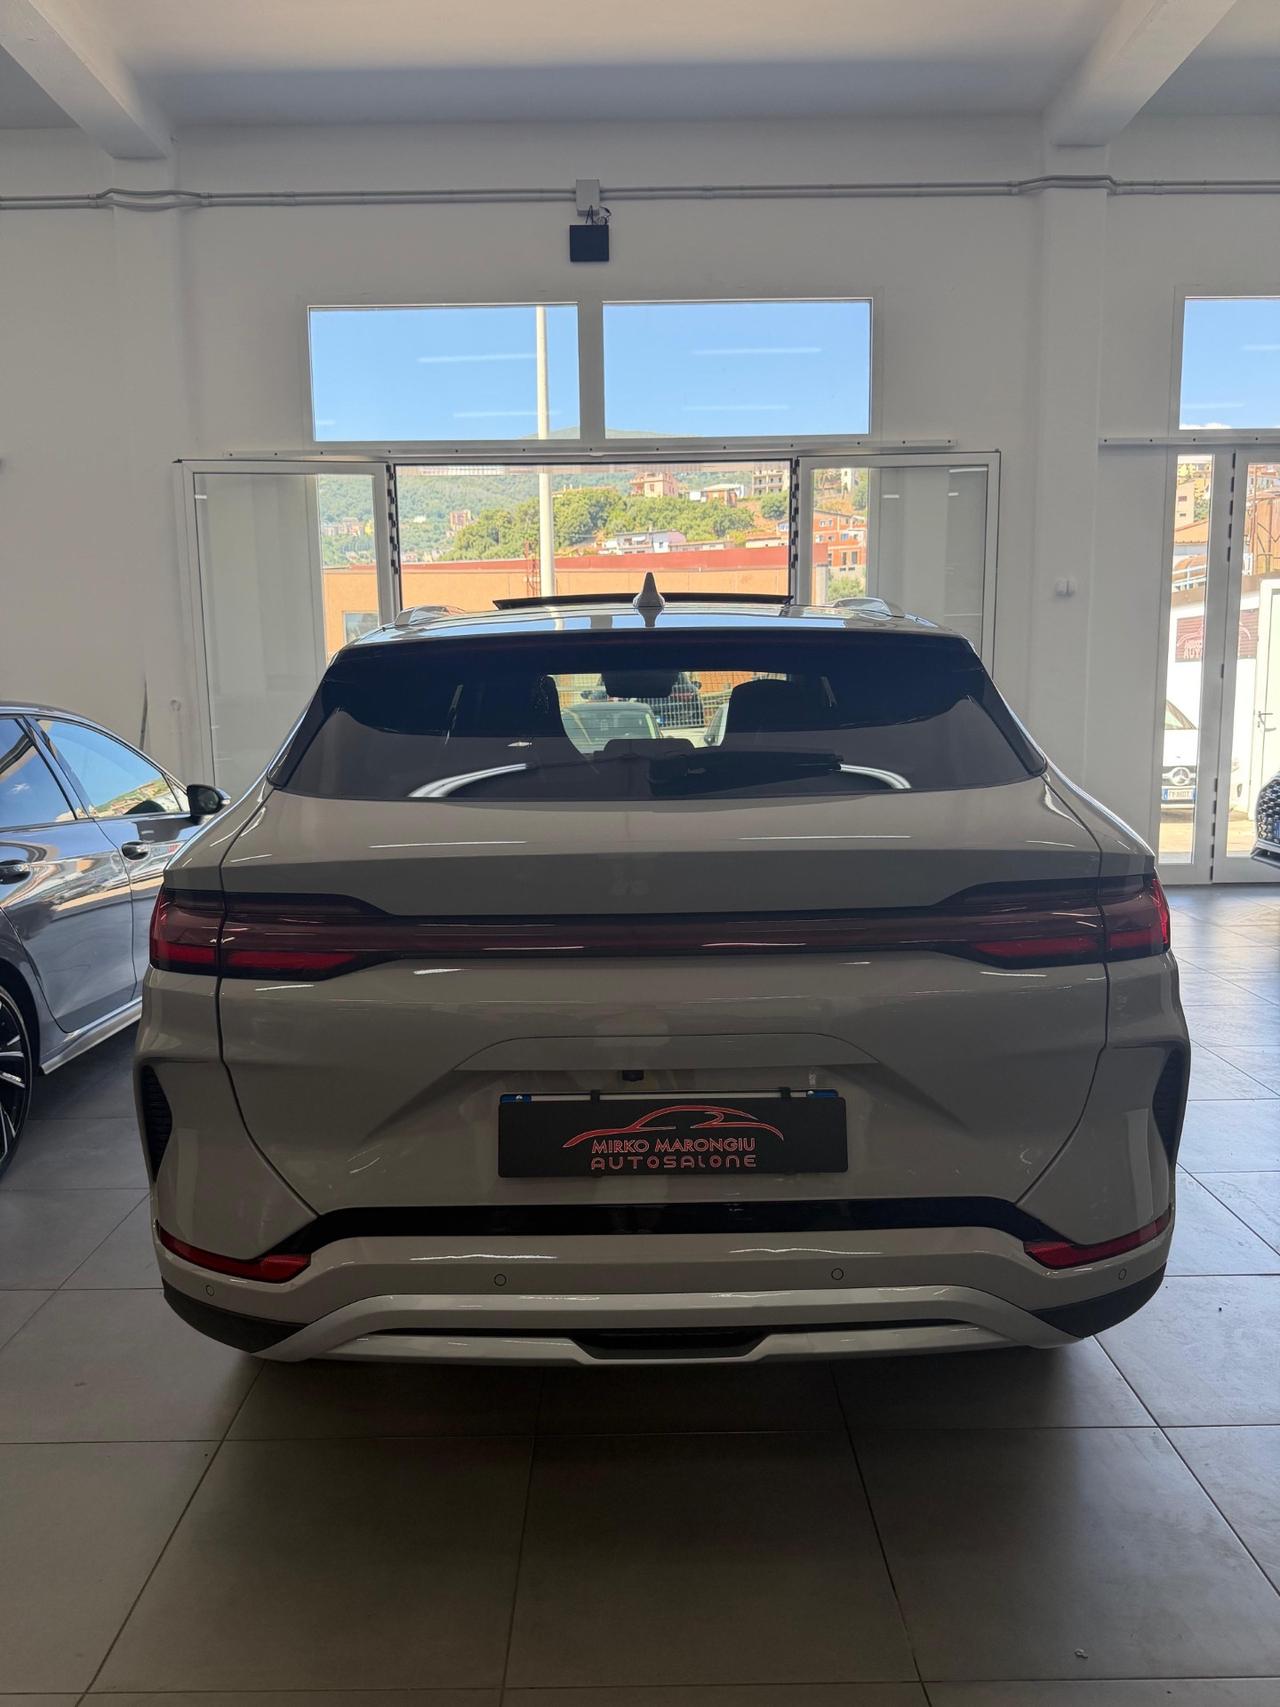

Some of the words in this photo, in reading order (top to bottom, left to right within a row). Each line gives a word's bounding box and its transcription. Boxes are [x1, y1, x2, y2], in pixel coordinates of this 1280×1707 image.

[591, 1139, 650, 1154] MIRKO
[655, 1138, 756, 1153] MARONGIU
[591, 1155, 757, 1170] AUTOSALONE
